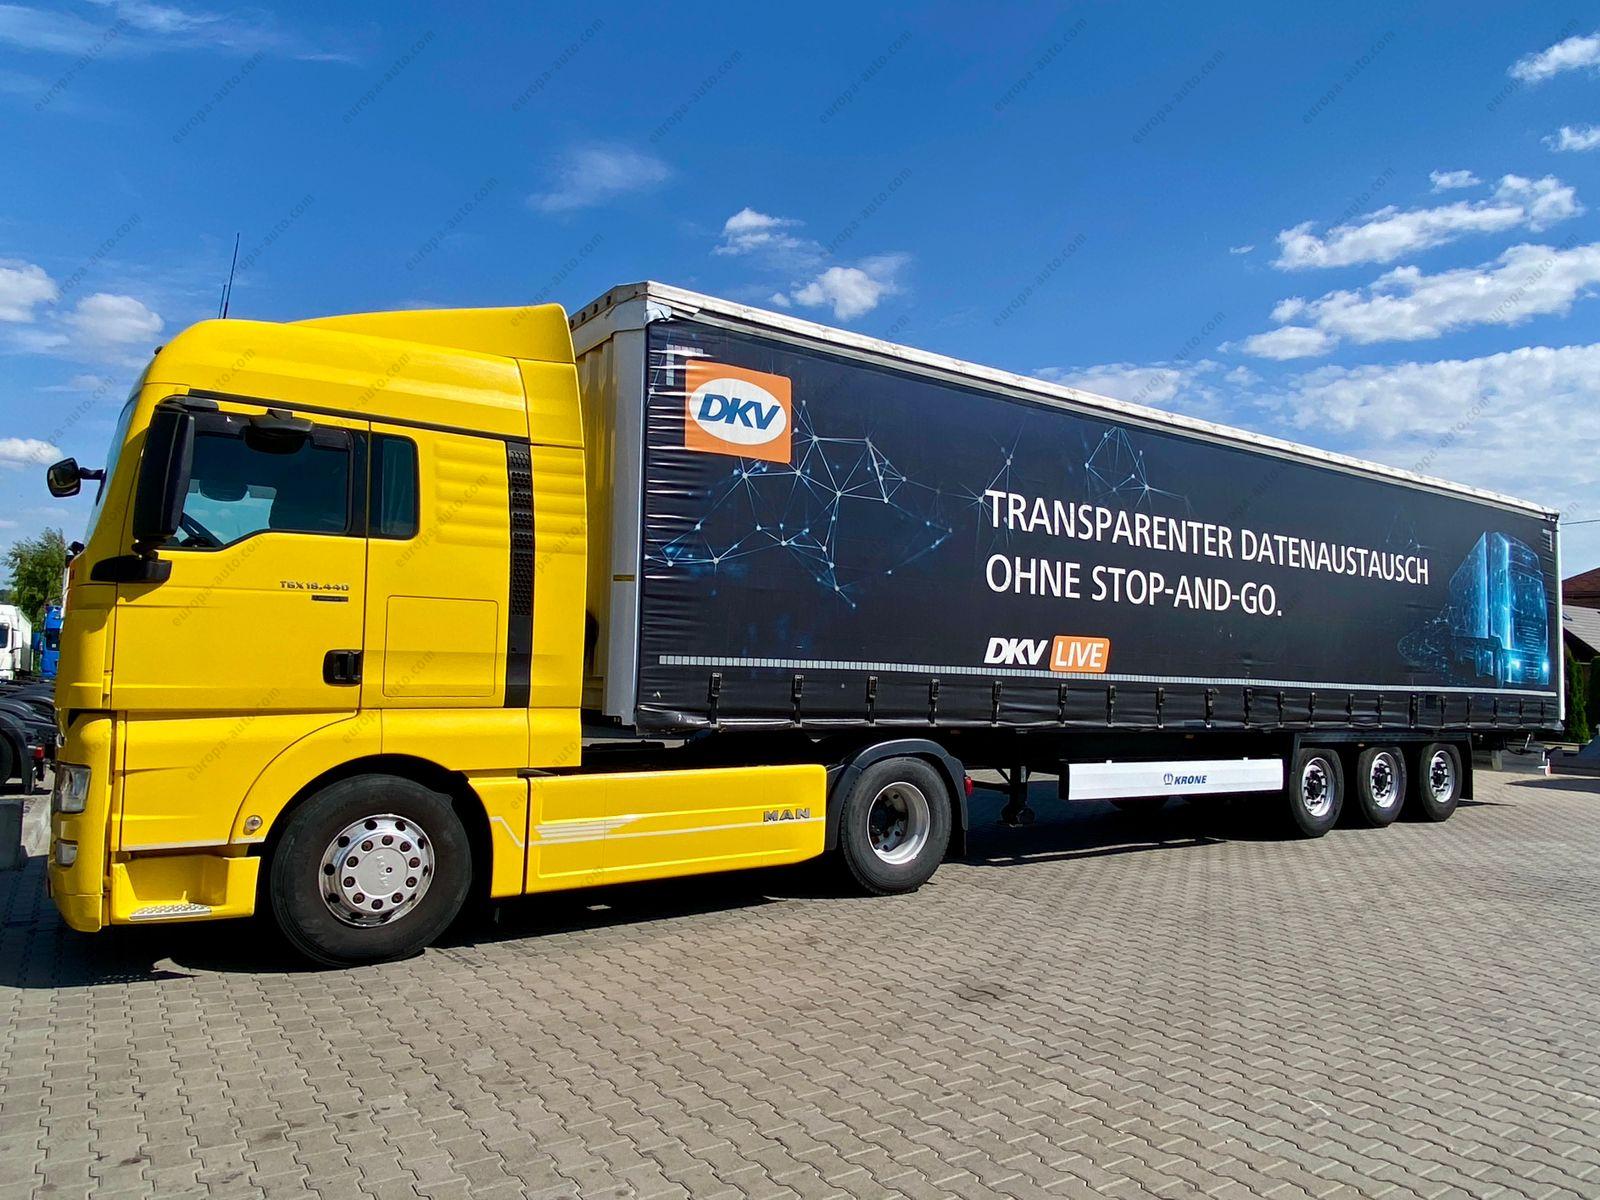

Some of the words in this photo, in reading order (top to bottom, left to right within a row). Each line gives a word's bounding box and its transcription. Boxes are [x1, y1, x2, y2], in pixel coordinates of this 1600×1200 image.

[697, 393, 781, 431] DKV
[985, 490, 1233, 559] TRANSPARENTER
[1241, 529, 1429, 585] DATENAUSTAUSCH
[987, 554, 1081, 599] OHNE
[1092, 566, 1282, 617] STOP-AND-GO.
[984, 637, 1048, 666] DKV
[1055, 641, 1105, 667] LIVE
[1174, 775, 1208, 785] KRONE
[763, 808, 811, 822] MAN
